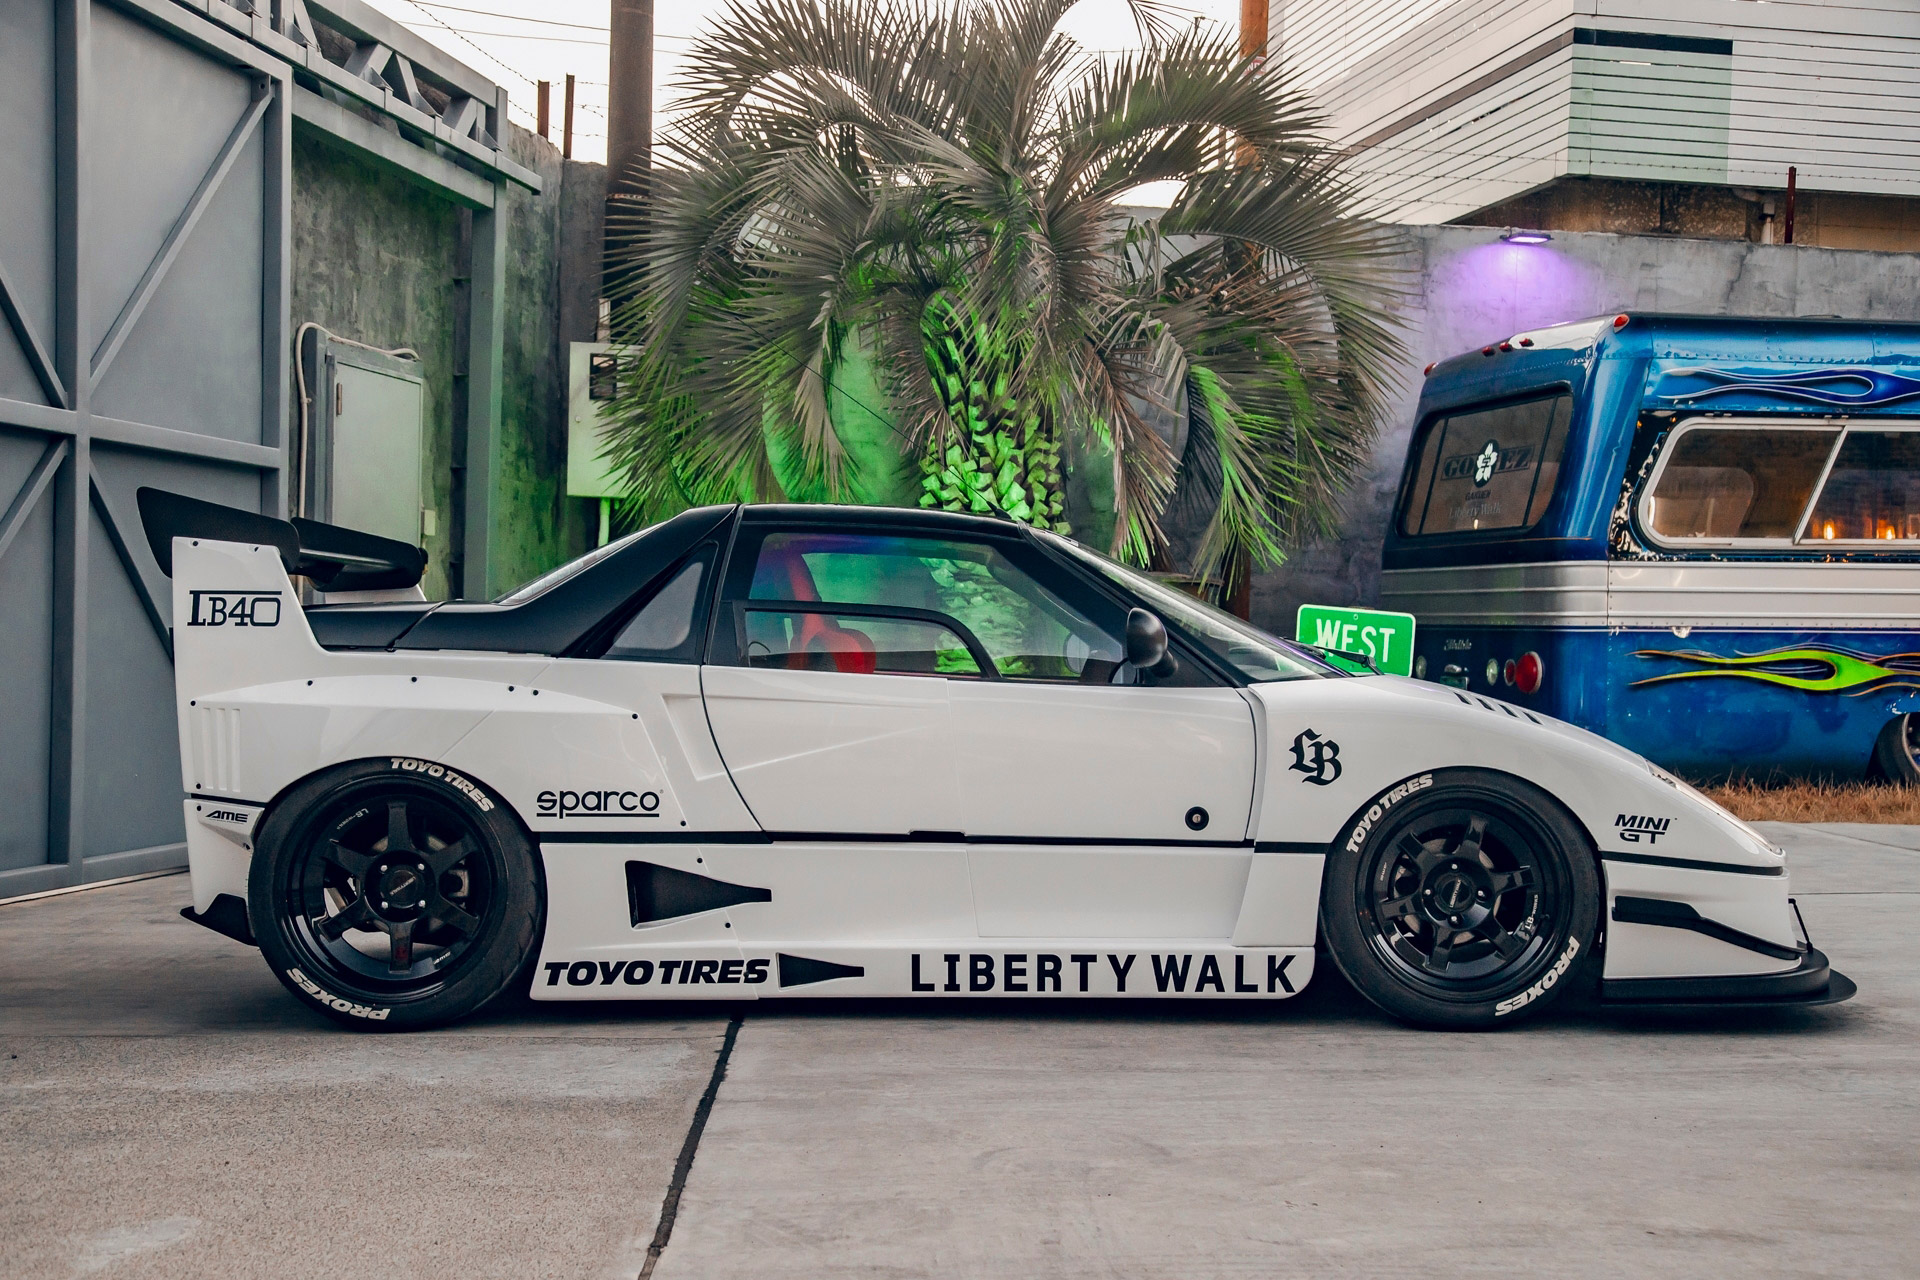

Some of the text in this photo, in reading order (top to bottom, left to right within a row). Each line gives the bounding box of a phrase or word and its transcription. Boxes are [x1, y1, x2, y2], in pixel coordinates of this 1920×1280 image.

[187, 590, 282, 627] LB40
[1316, 618, 1395, 662] WEST
[1288, 728, 1342, 786] LB
[390, 757, 495, 812] TOYO TIRES
[537, 790, 660, 819] sparco
[205, 810, 249, 823] AME
[1346, 774, 1433, 853] TOYO TIRES
[1614, 814, 1671, 831] MINI
[1620, 828, 1666, 844] GT
[544, 958, 771, 986] TOYO TIRES
[911, 953, 1297, 993] LIBERTY WALK
[1495, 936, 1580, 1017] PROXES
[286, 967, 391, 1021] PROXES
